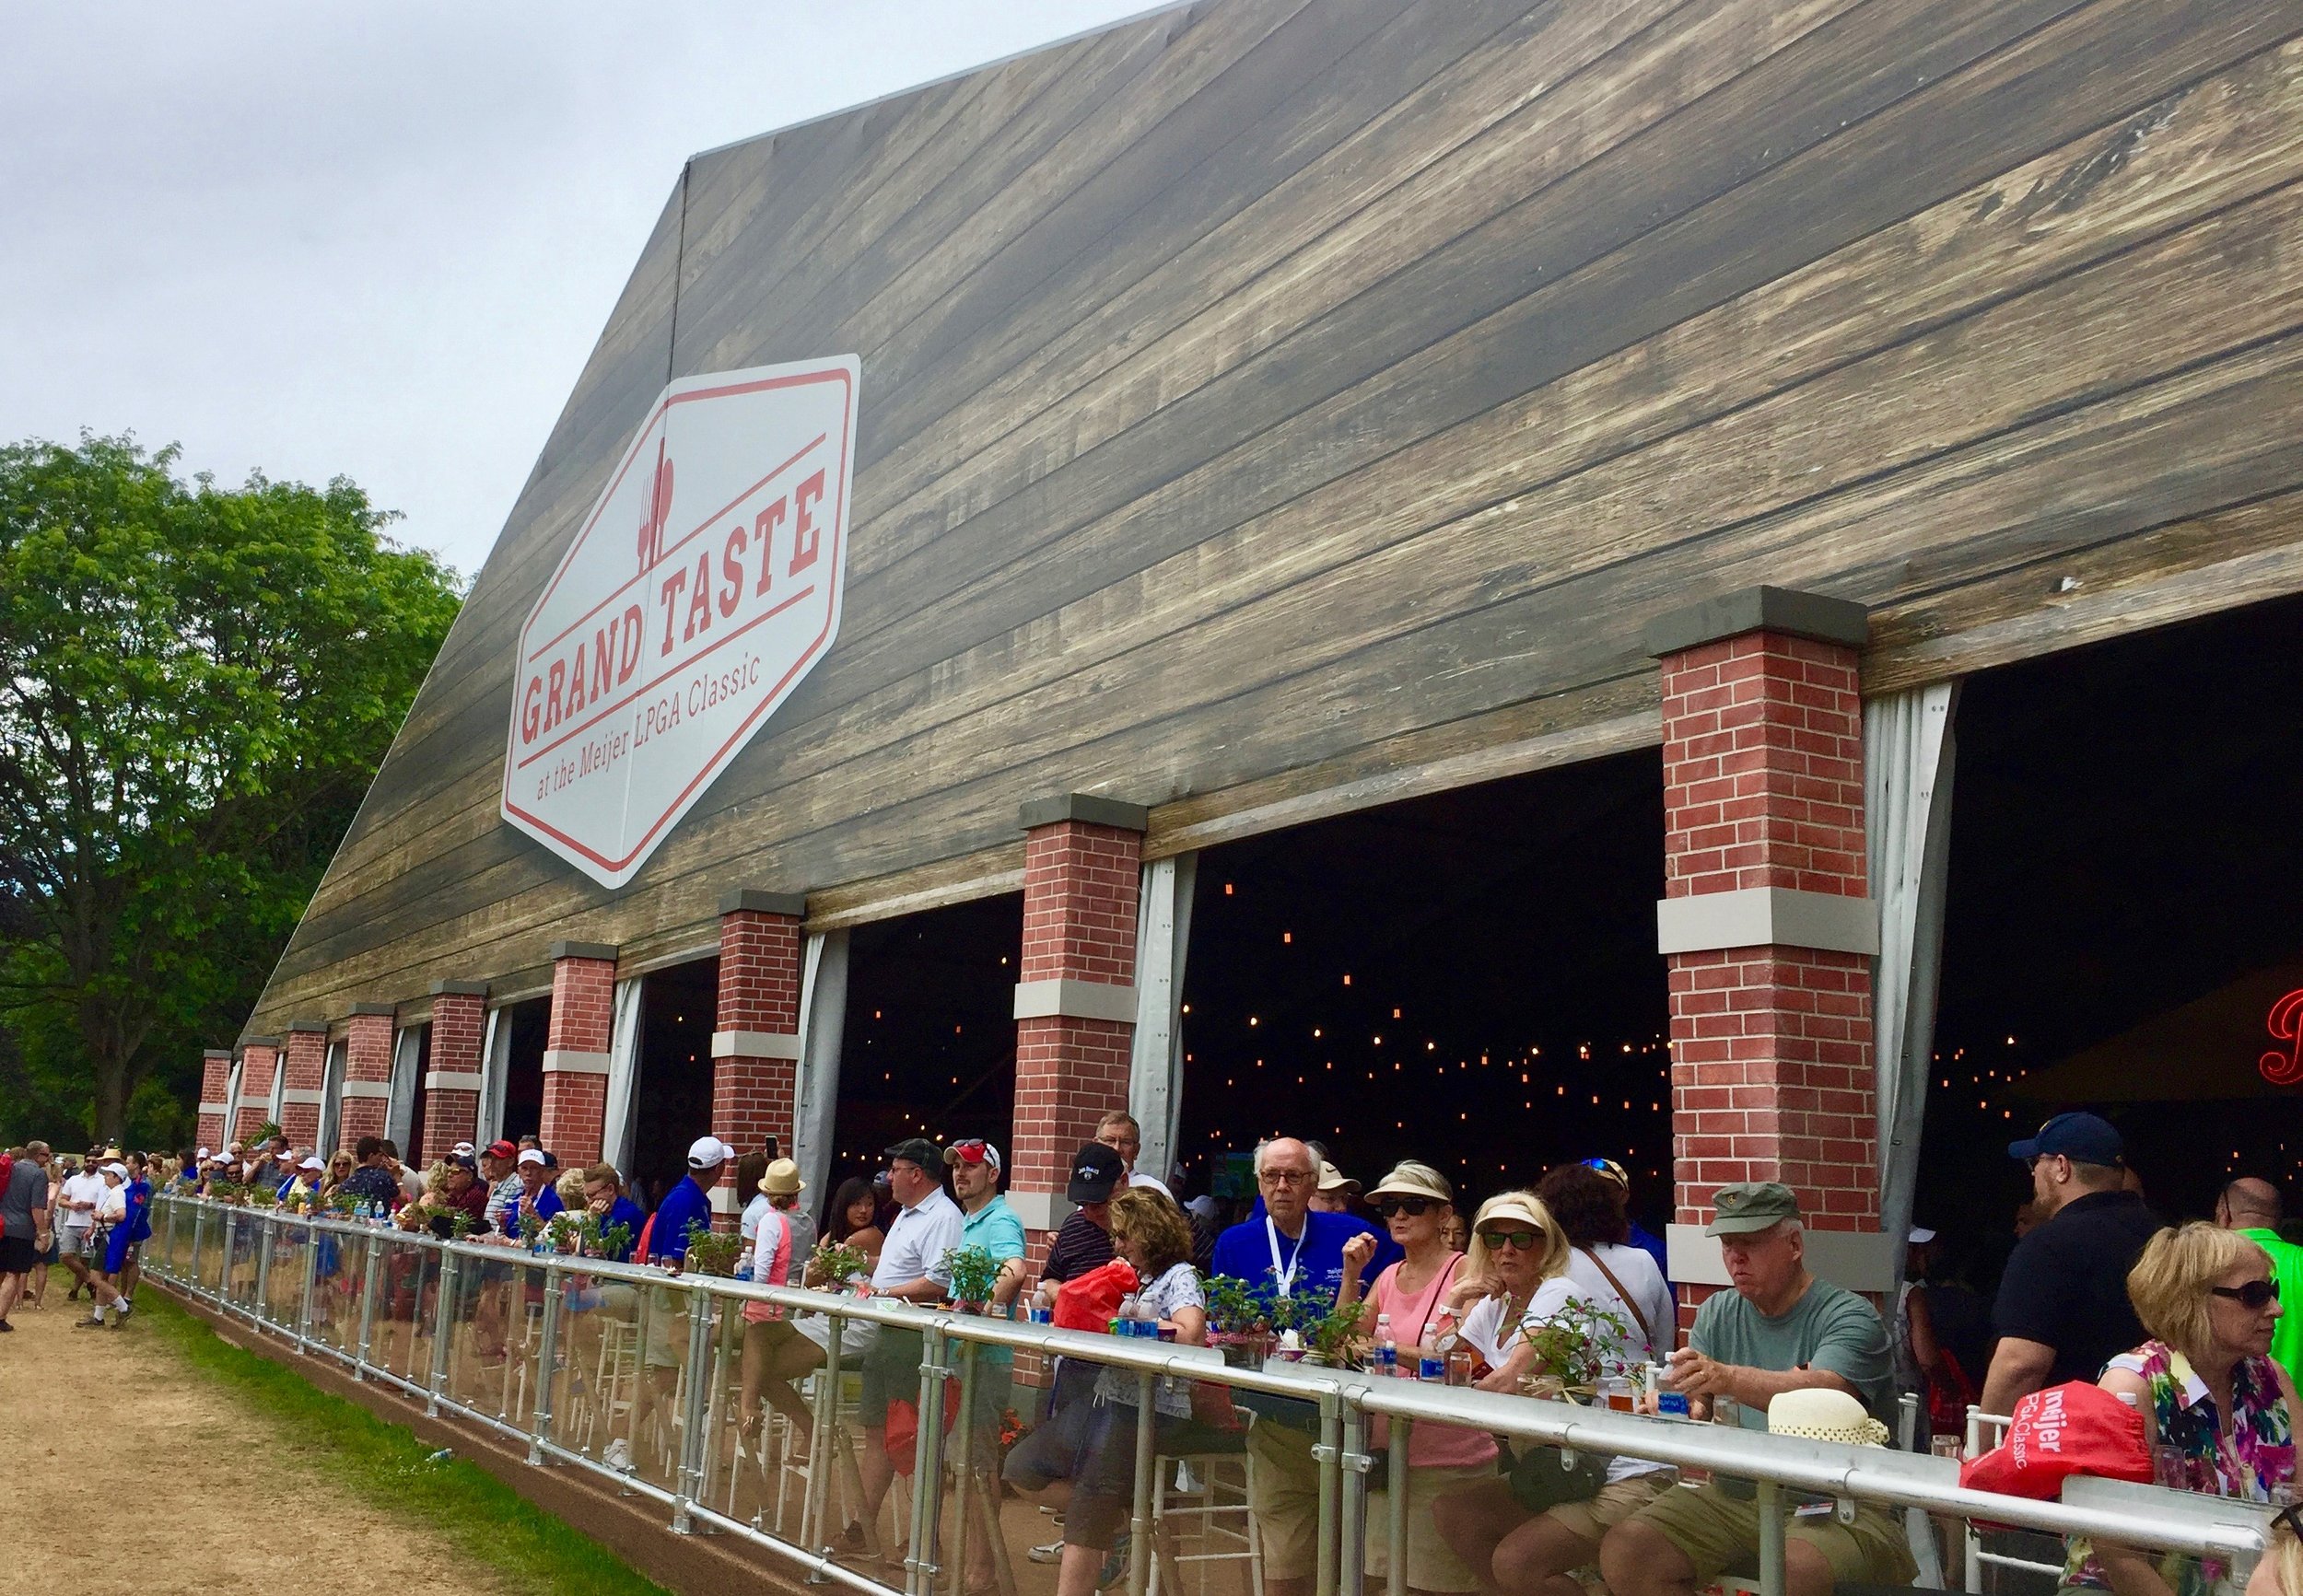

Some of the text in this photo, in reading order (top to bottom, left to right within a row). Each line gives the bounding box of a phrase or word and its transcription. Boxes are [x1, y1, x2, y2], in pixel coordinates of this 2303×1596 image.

[521, 466, 826, 746] GRAND TASTE
[537, 651, 762, 801] at the Meijer LPGA Classic
[2013, 1392, 2040, 1470] PGA Classic
[2033, 1390, 2067, 1452] meijer
